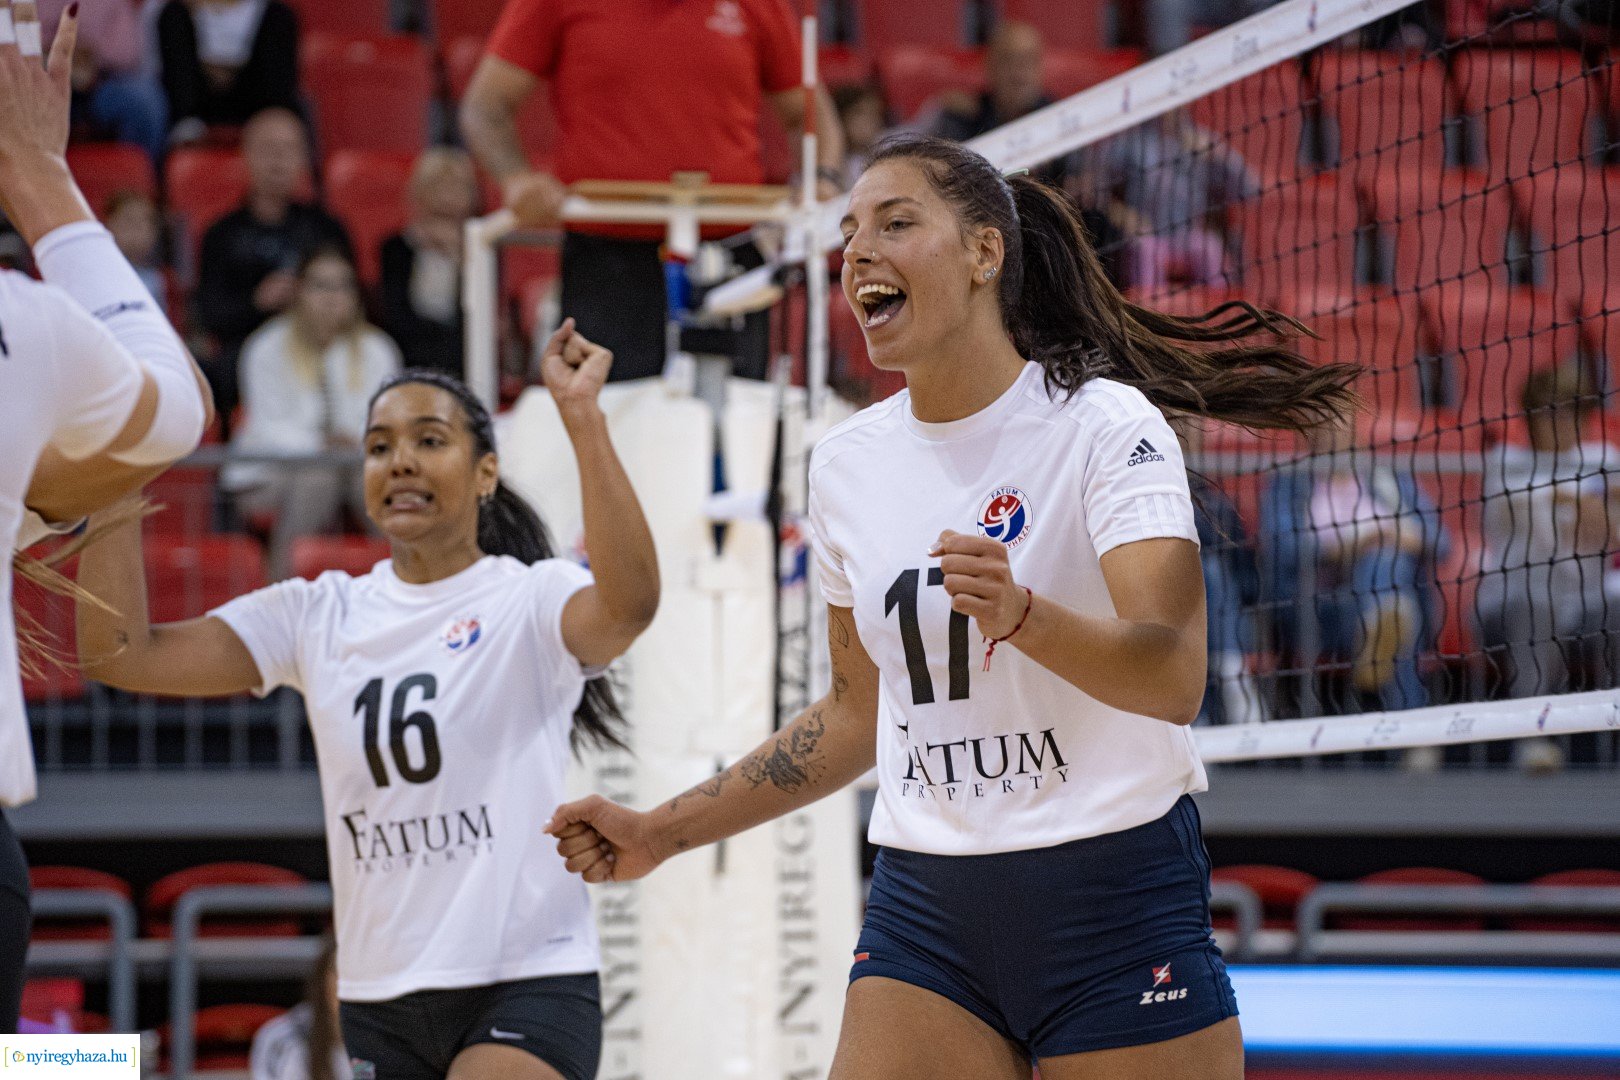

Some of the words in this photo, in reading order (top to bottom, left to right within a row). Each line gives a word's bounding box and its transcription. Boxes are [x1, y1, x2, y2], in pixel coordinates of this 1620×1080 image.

[1127, 453, 1165, 467] adidas
[991, 488, 1018, 500] FATUM
[884, 567, 970, 706] 17
[352, 673, 442, 788] 16
[341, 804, 493, 860] FATUM
[1139, 987, 1188, 1005] Zeus
